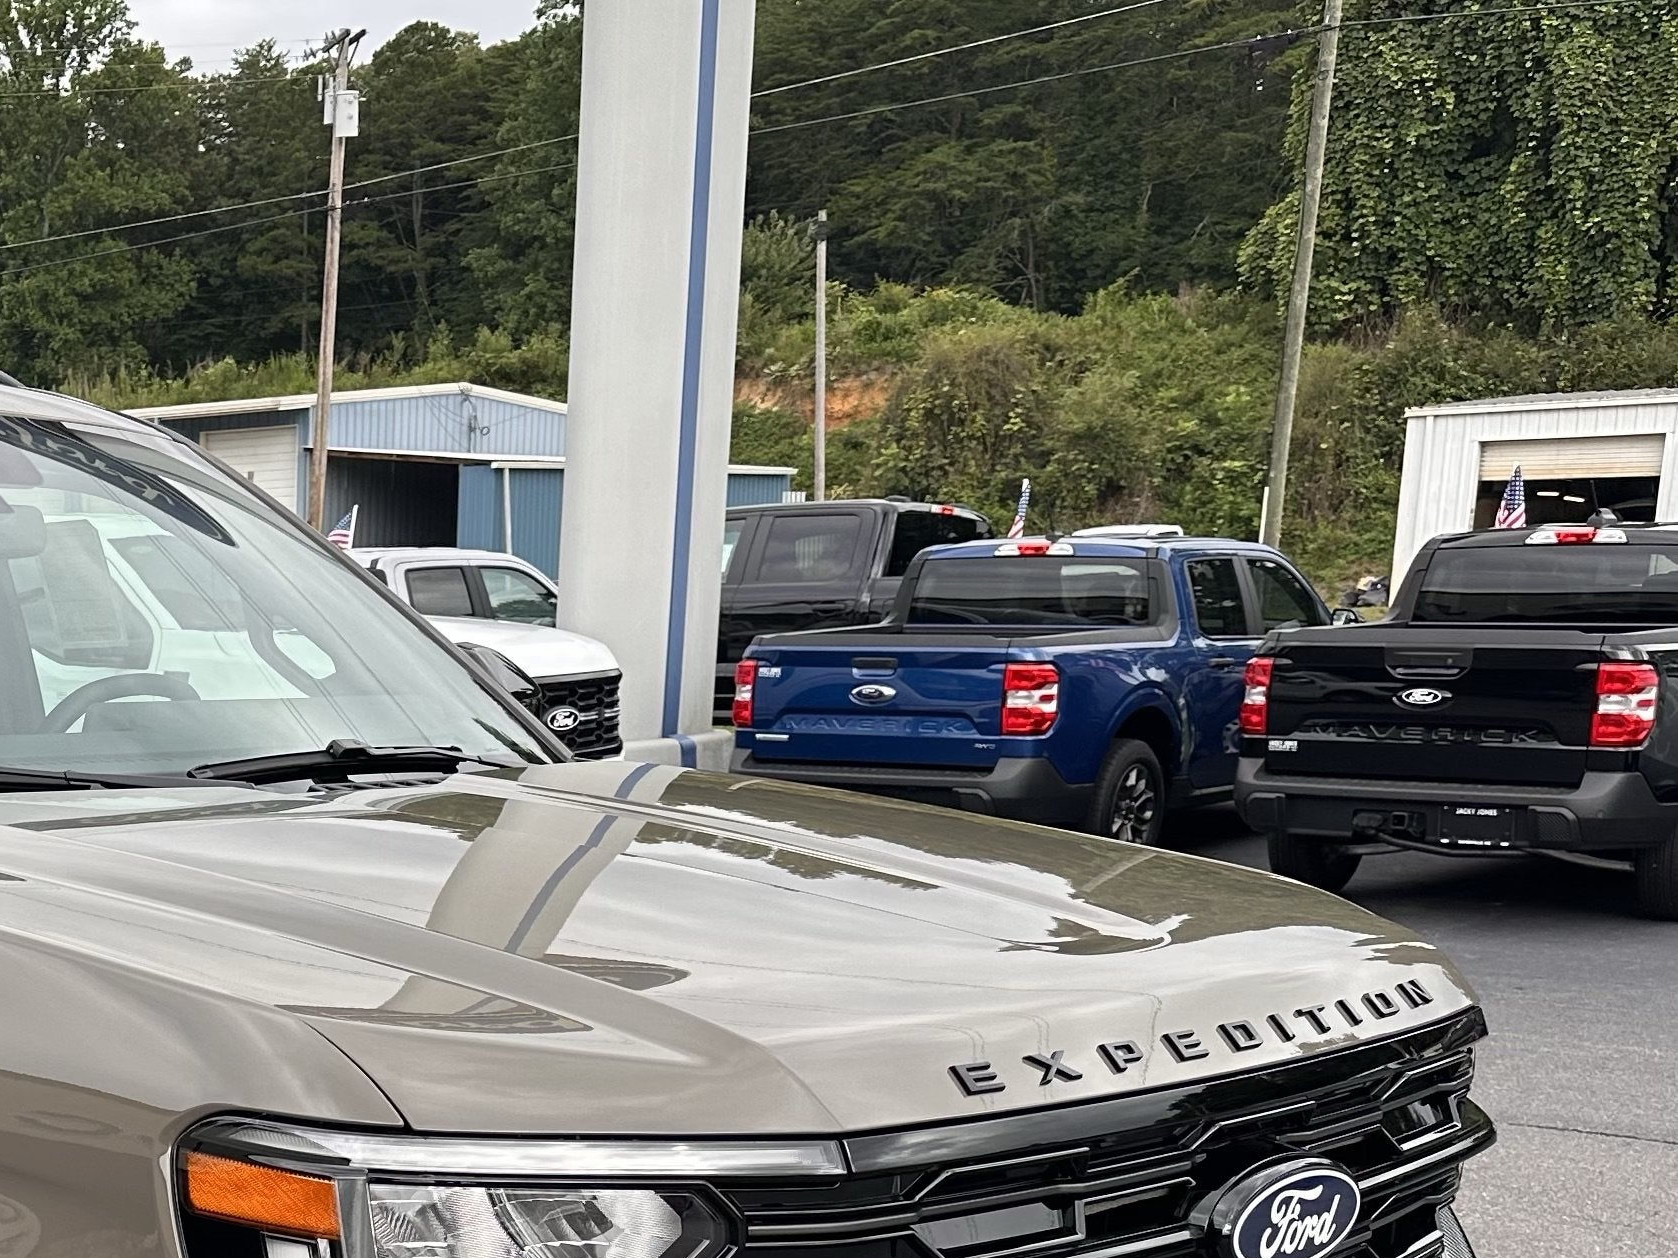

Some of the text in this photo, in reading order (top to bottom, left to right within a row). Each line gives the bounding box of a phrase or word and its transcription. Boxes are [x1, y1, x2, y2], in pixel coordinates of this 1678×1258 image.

[785, 717, 965, 733] MAVERICK
[1311, 724, 1538, 743] MAVERICK
[947, 978, 1435, 1097] EXPEDITION
